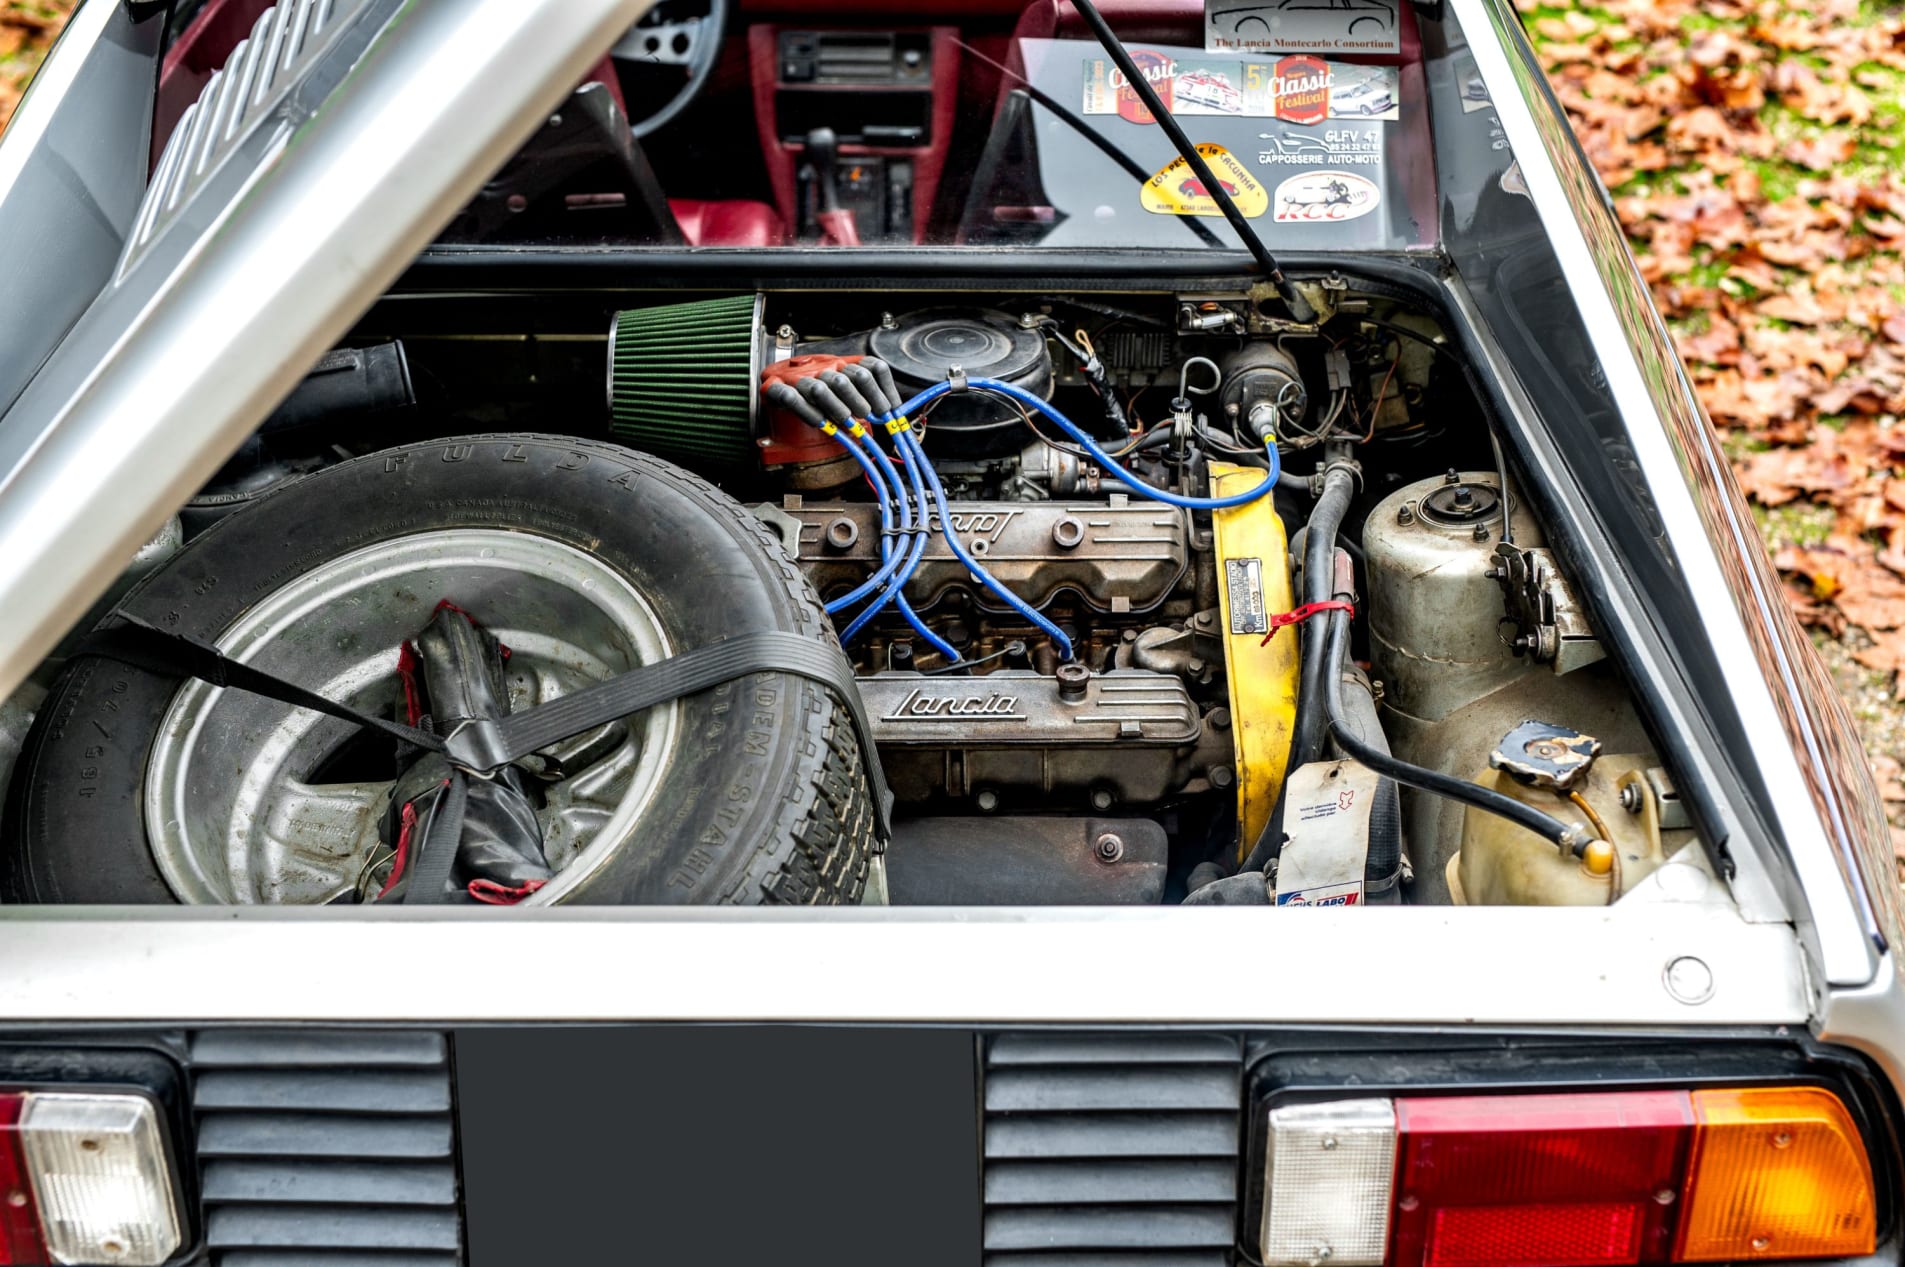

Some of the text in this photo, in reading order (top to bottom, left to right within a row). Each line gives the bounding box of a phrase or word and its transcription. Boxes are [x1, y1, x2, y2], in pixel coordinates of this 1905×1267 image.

[1215, 38, 1394, 49] The Lancia Montecarlo Consortium
[1267, 69, 1335, 98] Classic
[1276, 90, 1325, 111] Festival
[1325, 130, 1380, 143] GLFV 47
[1327, 154, 1381, 164] AUTO-MOTO
[1152, 171, 1169, 188] LOS
[1278, 202, 1346, 219] RCC
[384, 443, 642, 493] FULDA
[882, 688, 1028, 722] Lancia
